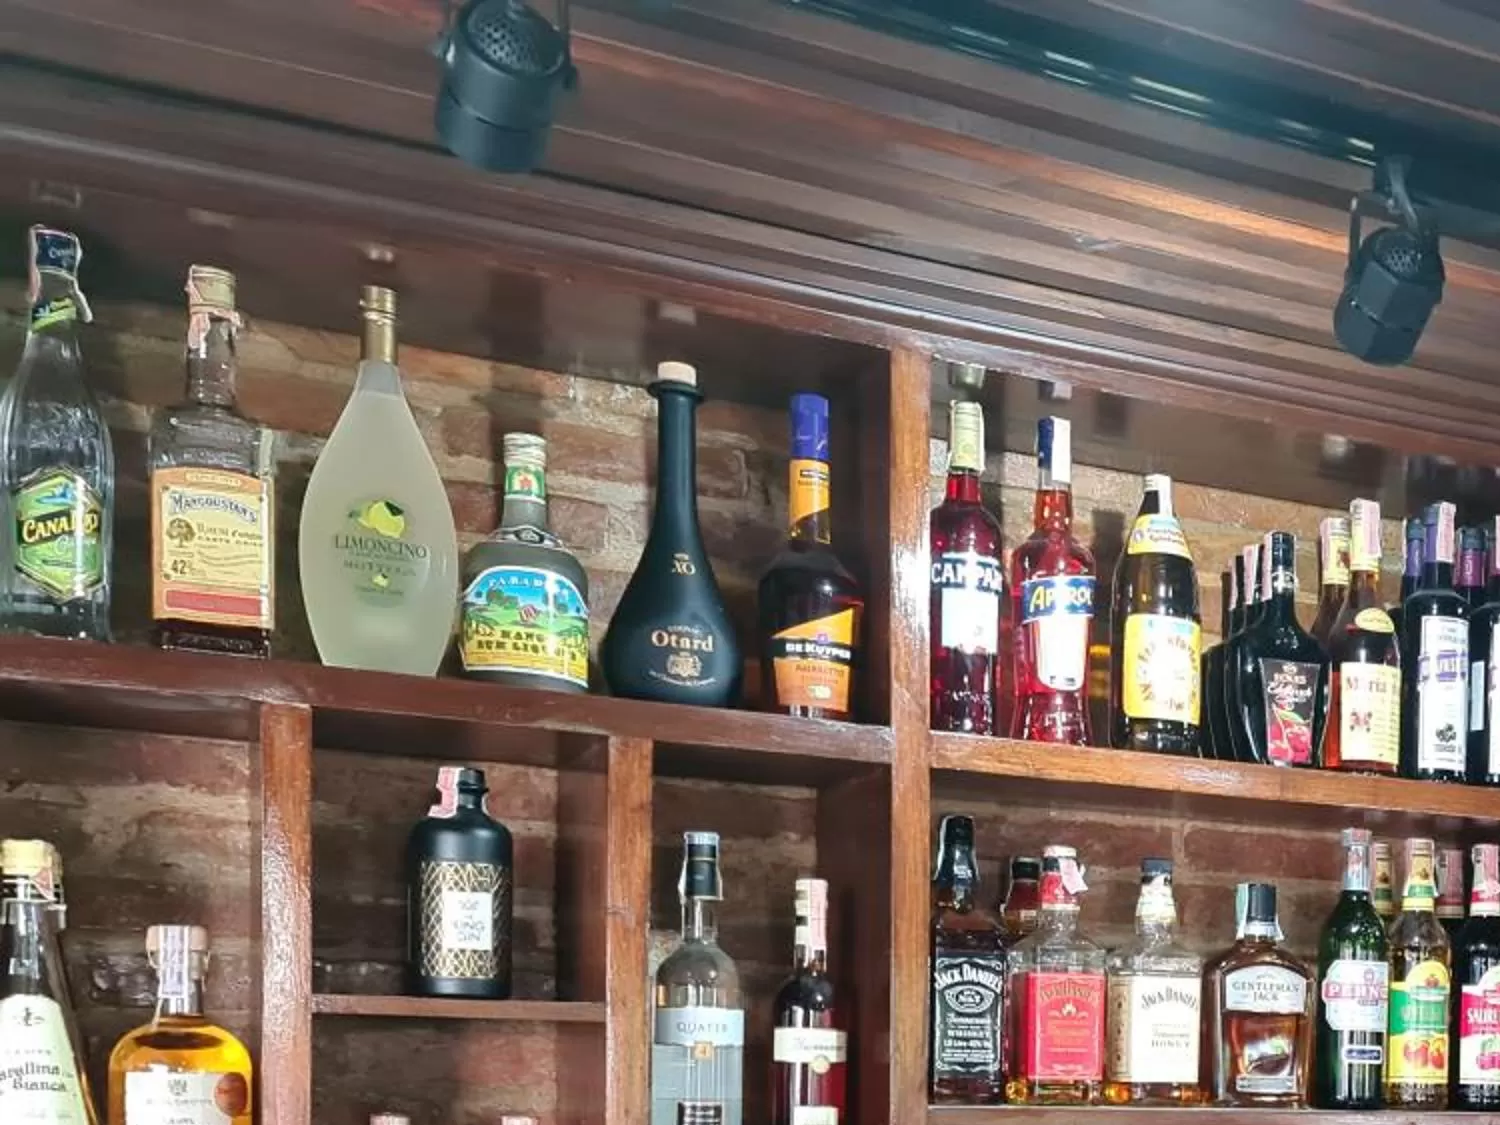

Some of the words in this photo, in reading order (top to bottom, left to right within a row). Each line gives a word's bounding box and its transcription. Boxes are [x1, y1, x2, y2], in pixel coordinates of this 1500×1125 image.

[334, 535, 427, 558] LIMONCINO
[673, 560, 696, 575] XO
[652, 630, 714, 653] Otard
[1232, 980, 1299, 994] GENTLEMAN
[1253, 992, 1279, 1001] JACK
